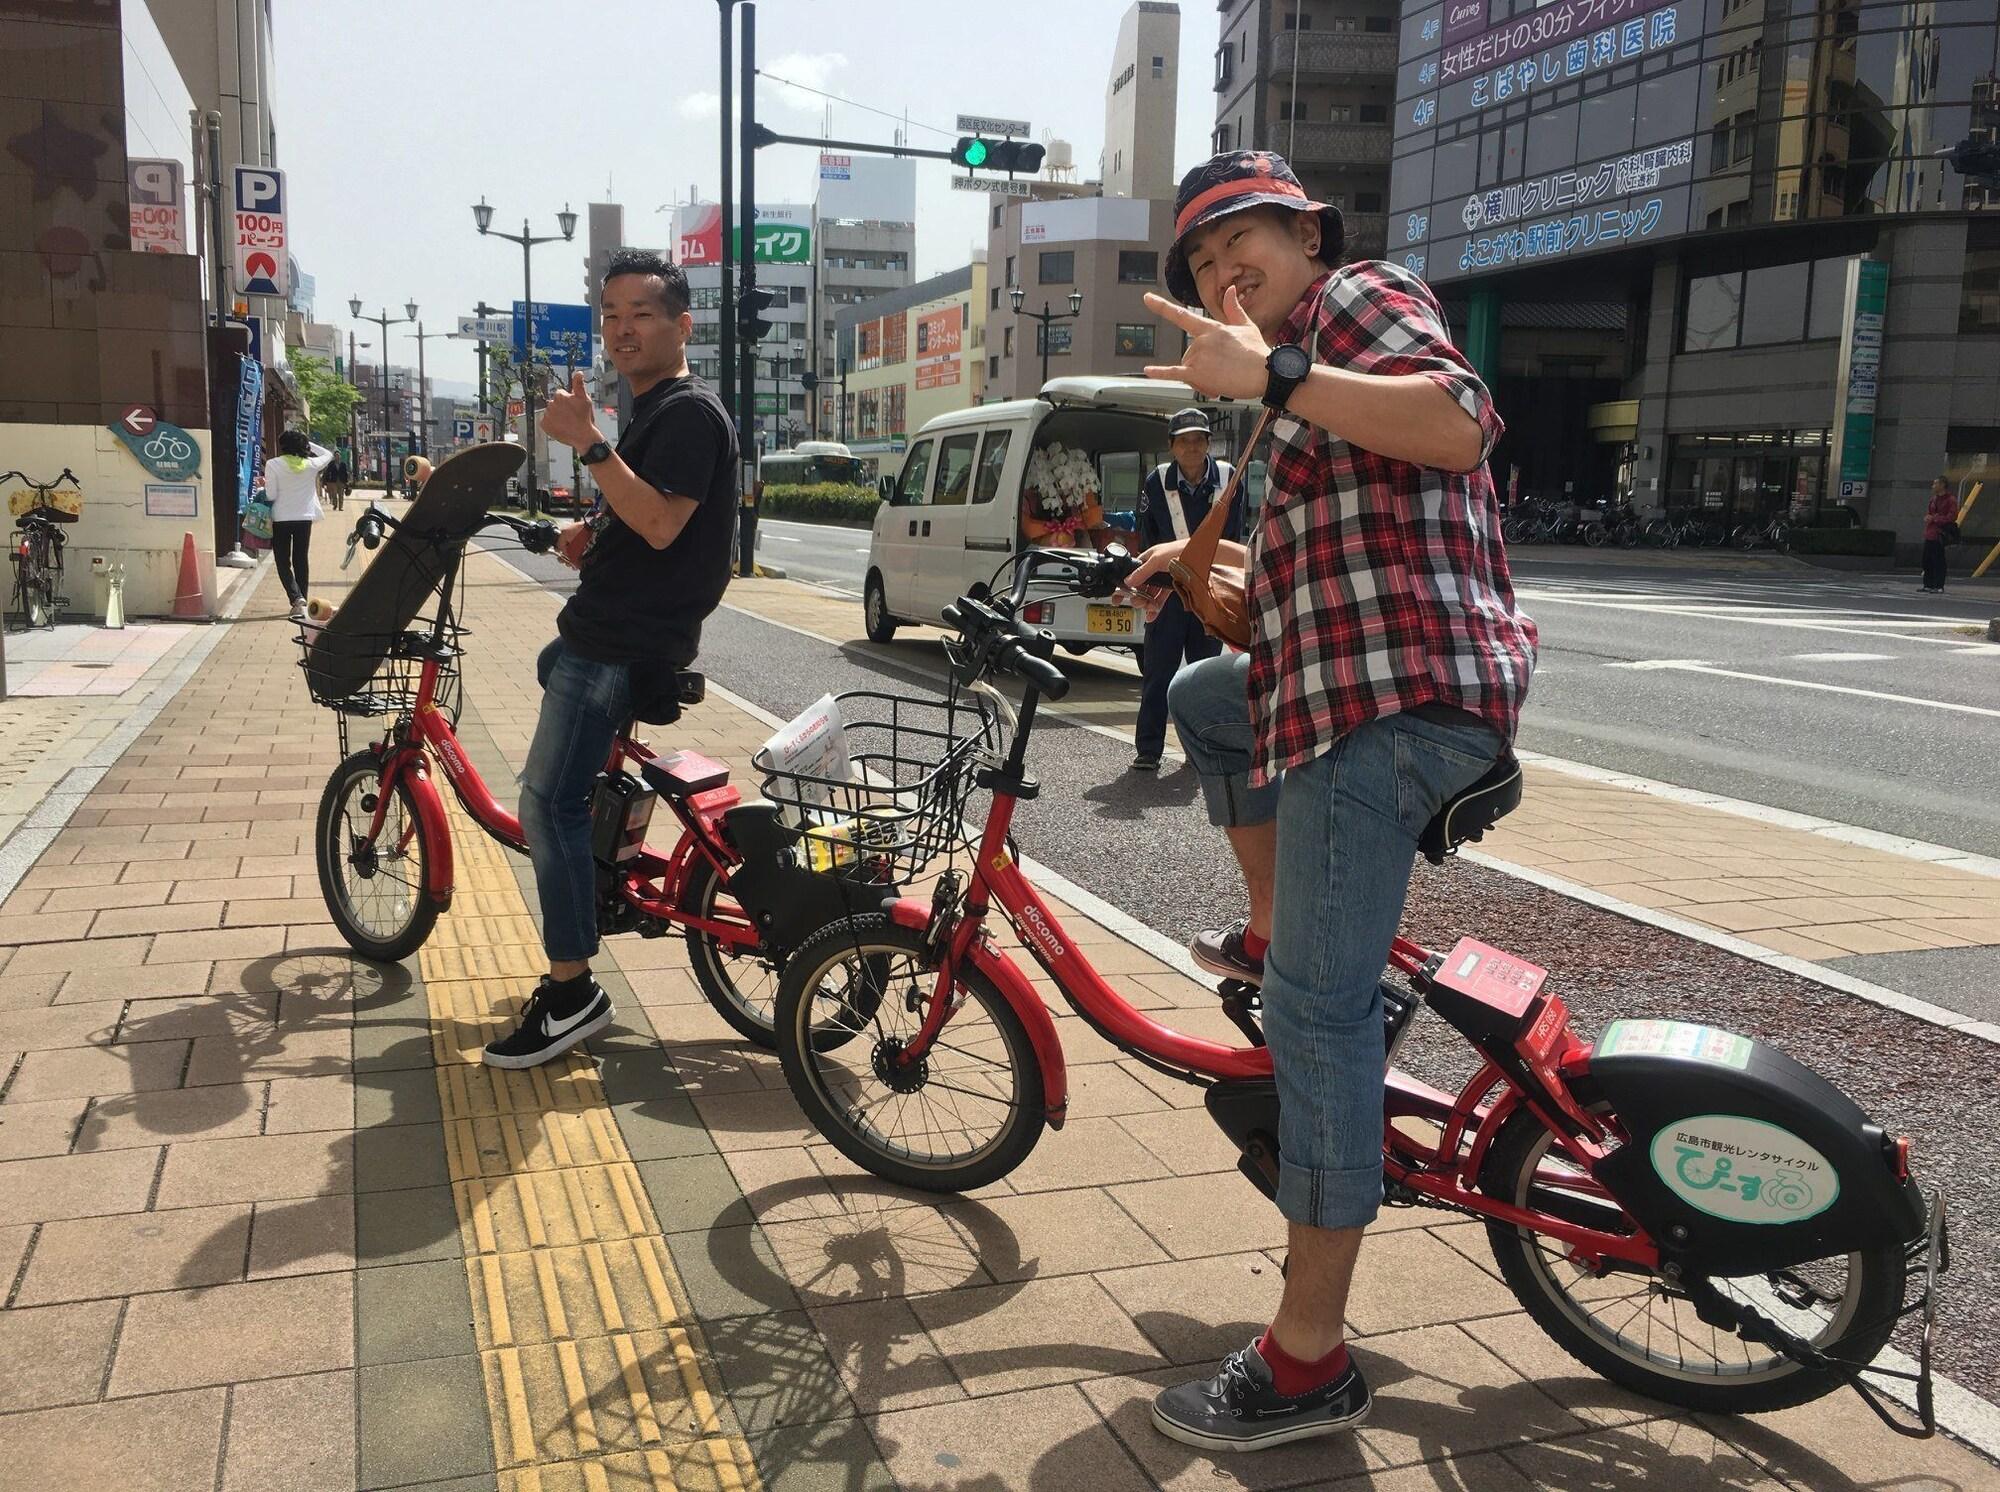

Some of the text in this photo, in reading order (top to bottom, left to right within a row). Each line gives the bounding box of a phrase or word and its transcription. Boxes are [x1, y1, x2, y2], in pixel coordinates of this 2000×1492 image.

[1450, 2, 1480, 25] Curves
[1421, 18, 1440, 41] 4F
[1471, 7, 1677, 107] こばやし歯科医院
[1418, 62, 1437, 84] 4F
[1412, 98, 1435, 126] 4F
[241, 171, 278, 209] P
[954, 177, 1028, 195] 押ボタン式信号機
[1484, 162, 1616, 225] 横川クリニック
[235, 213, 284, 233] 100円
[1407, 213, 1427, 241] 3F
[1458, 198, 1663, 271] よこがわ駅前クリニック
[236, 232, 284, 247] パーク
[754, 231, 801, 256] イク
[1405, 253, 1425, 276] 2F
[457, 422, 471, 437] P
[1842, 483, 1853, 496] P
[441, 739, 465, 773] docomo
[1024, 905, 1064, 956] docomo
[1676, 1131, 1820, 1172] 広島市観光レンタサイクル
